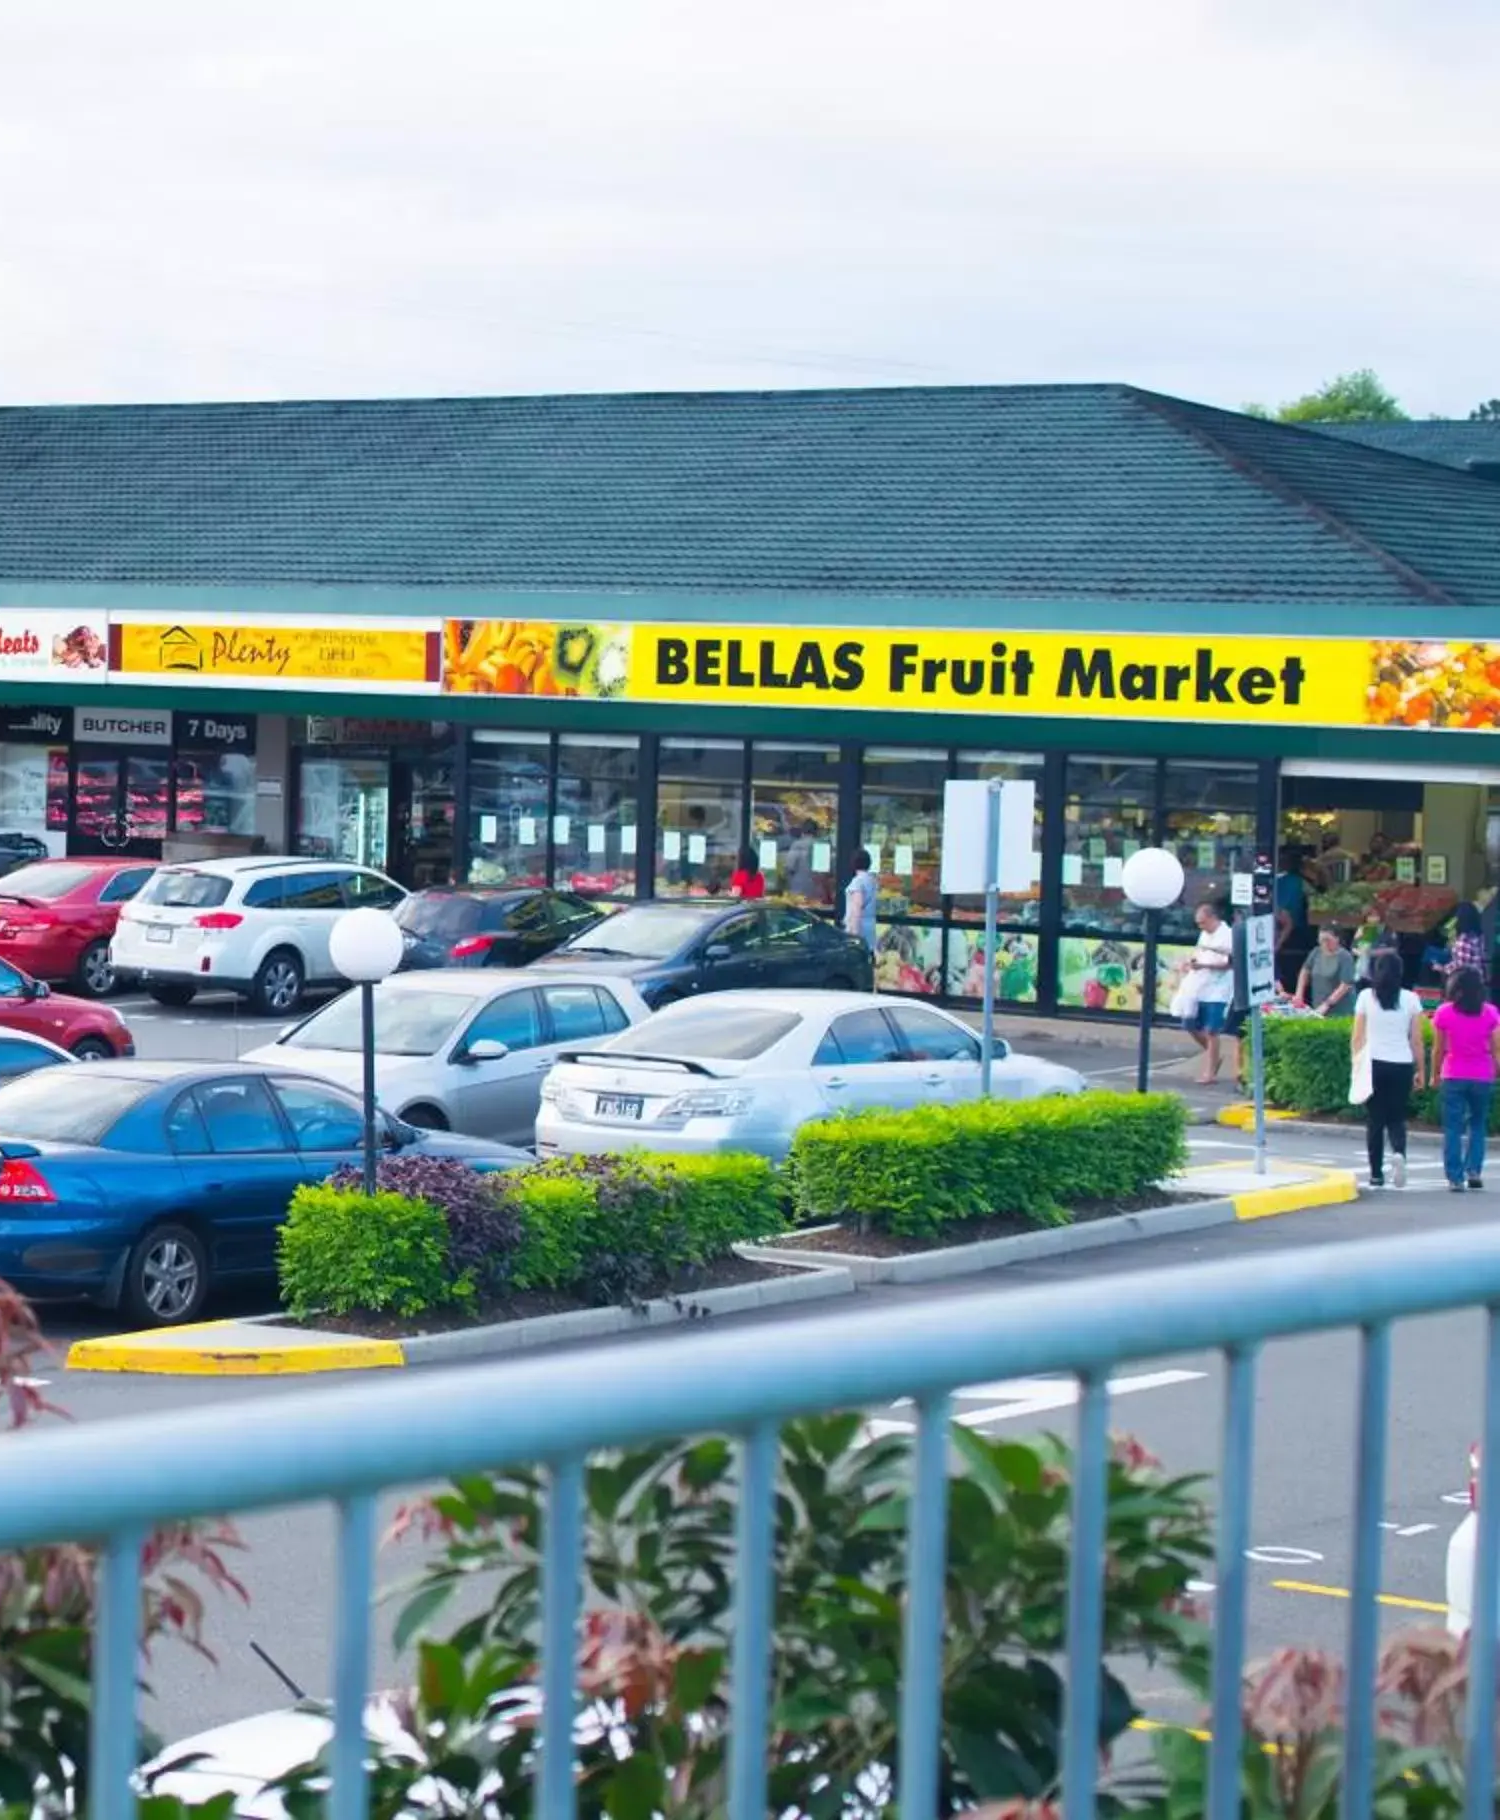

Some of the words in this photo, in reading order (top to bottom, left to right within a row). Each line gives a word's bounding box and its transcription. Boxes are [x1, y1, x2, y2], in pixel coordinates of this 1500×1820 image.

[211, 631, 291, 675] Plenty
[656, 637, 865, 692] BELLAS
[888, 641, 1035, 696] Fruit
[1055, 647, 1306, 705] Market
[82, 717, 167, 735] BUTCHER
[188, 719, 199, 737] 7
[204, 718, 248, 744] Days
